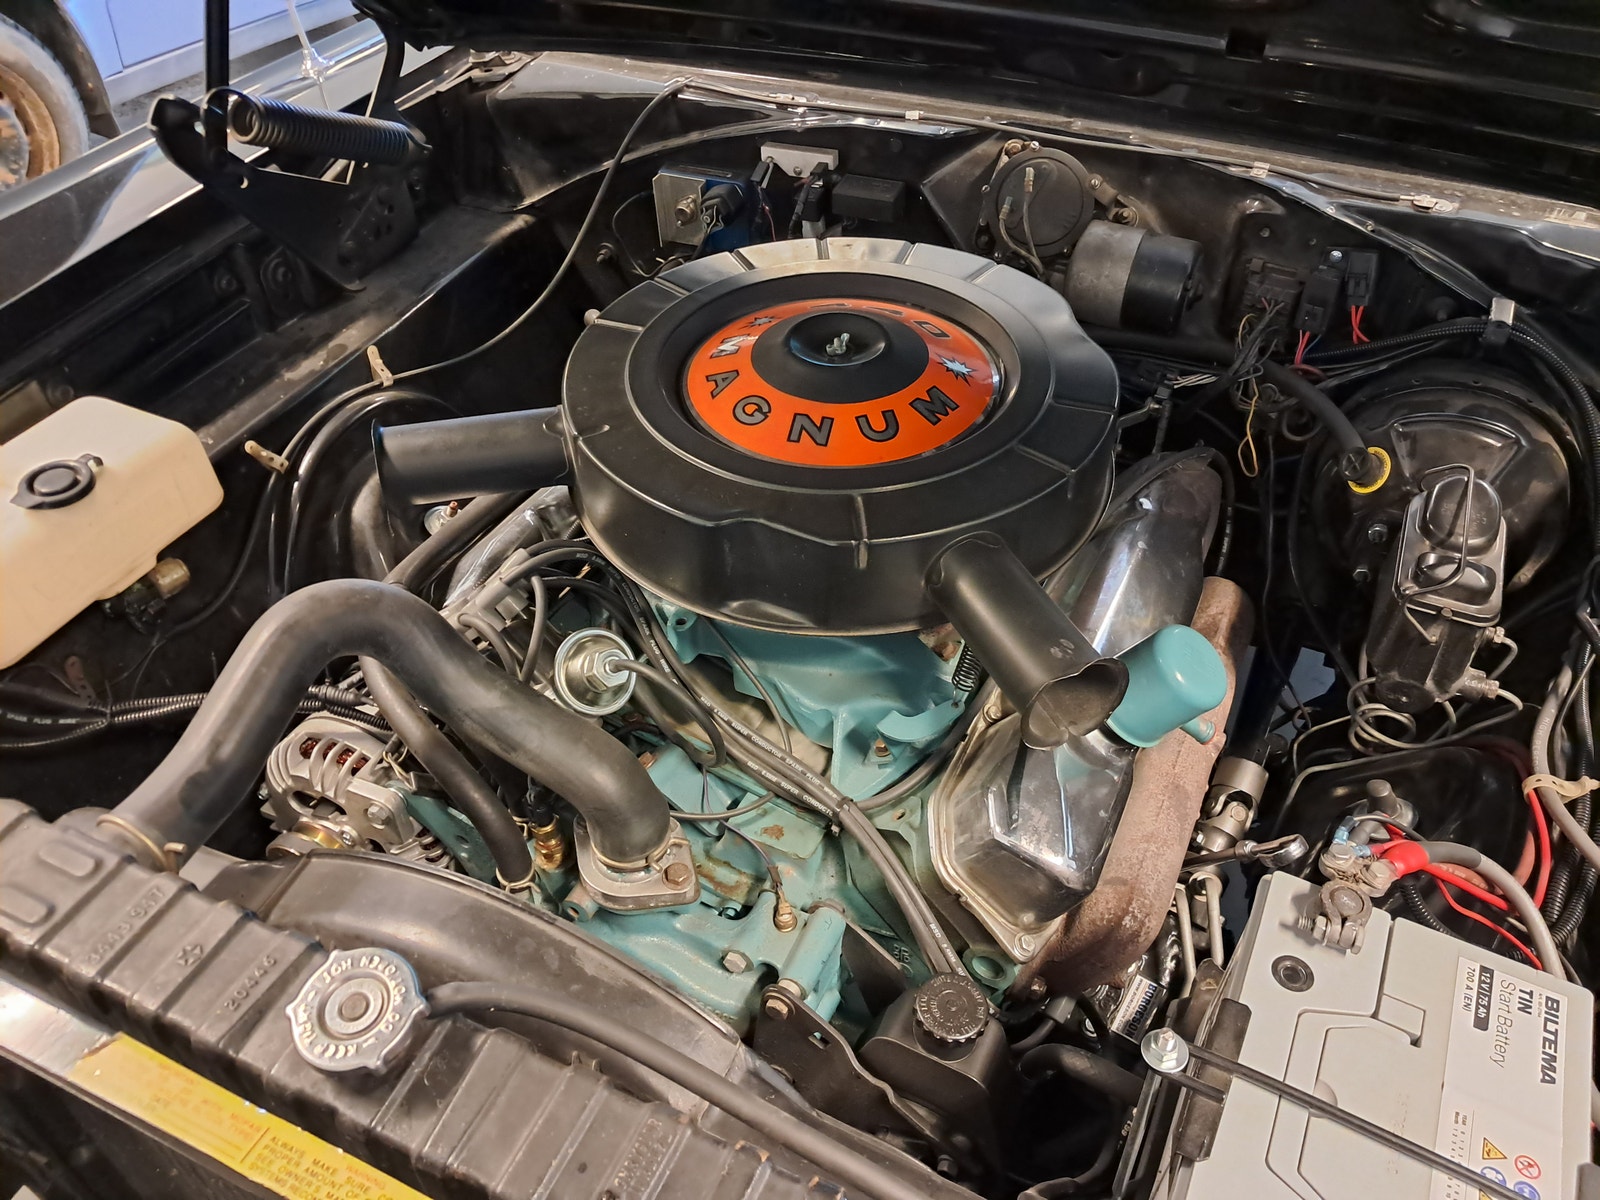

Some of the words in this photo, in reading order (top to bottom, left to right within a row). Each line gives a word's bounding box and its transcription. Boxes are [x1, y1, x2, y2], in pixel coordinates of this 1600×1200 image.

[705, 333, 960, 447] MAGNUM
[649, 639, 661, 656] PLUG
[731, 722, 749, 736] SUPER
[751, 736, 782, 759] CONDUCTOR
[784, 758, 804, 773] SPARK
[805, 772, 821, 786] PLUG
[780, 781, 800, 795] SUPER
[802, 794, 833, 816] CONDUCT
[929, 923, 942, 938] MSD
[223, 953, 278, 1011] 20446
[1466, 966, 1476, 983] 700
[1125, 982, 1158, 1039] BORGESON
[1461, 992, 1473, 1012] (EN)
[1477, 1005, 1487, 1018] Ah
[1498, 979, 1517, 1017] Start
[1517, 988, 1534, 1015] TIN
[1489, 1014, 1514, 1068] Battery
[1540, 995, 1560, 1085] BILTEMA
[262, 1144, 301, 1169] PROPER
[304, 1166, 343, 1191] AMOUNT
[270, 1136, 305, 1159] ALWAYS
[312, 1158, 338, 1176] MAKE
[346, 1176, 371, 1194] SURE
